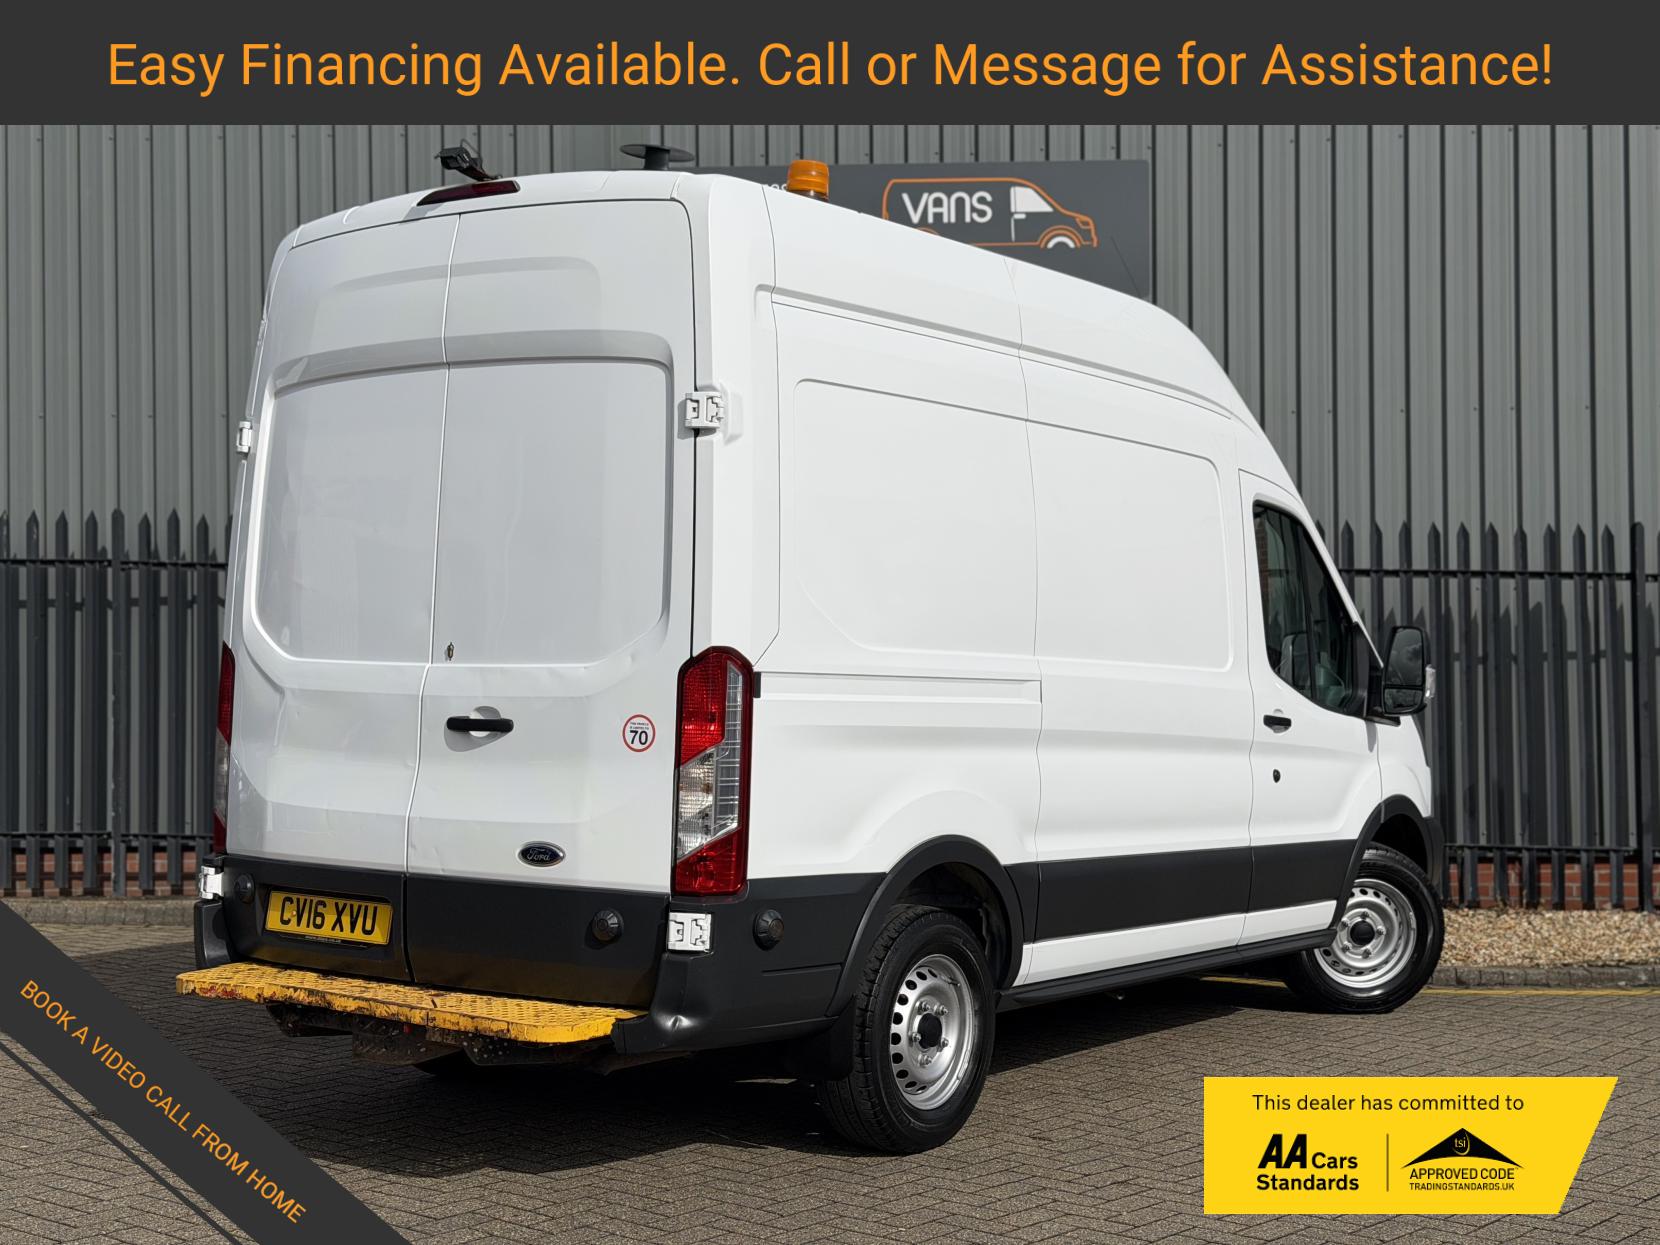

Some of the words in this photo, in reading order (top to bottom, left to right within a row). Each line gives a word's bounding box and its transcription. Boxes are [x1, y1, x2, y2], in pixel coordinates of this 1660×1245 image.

[901, 191, 993, 224] VANS
[629, 729, 649, 745] 70
[280, 896, 327, 930] CV16
[331, 901, 378, 936] XVU
